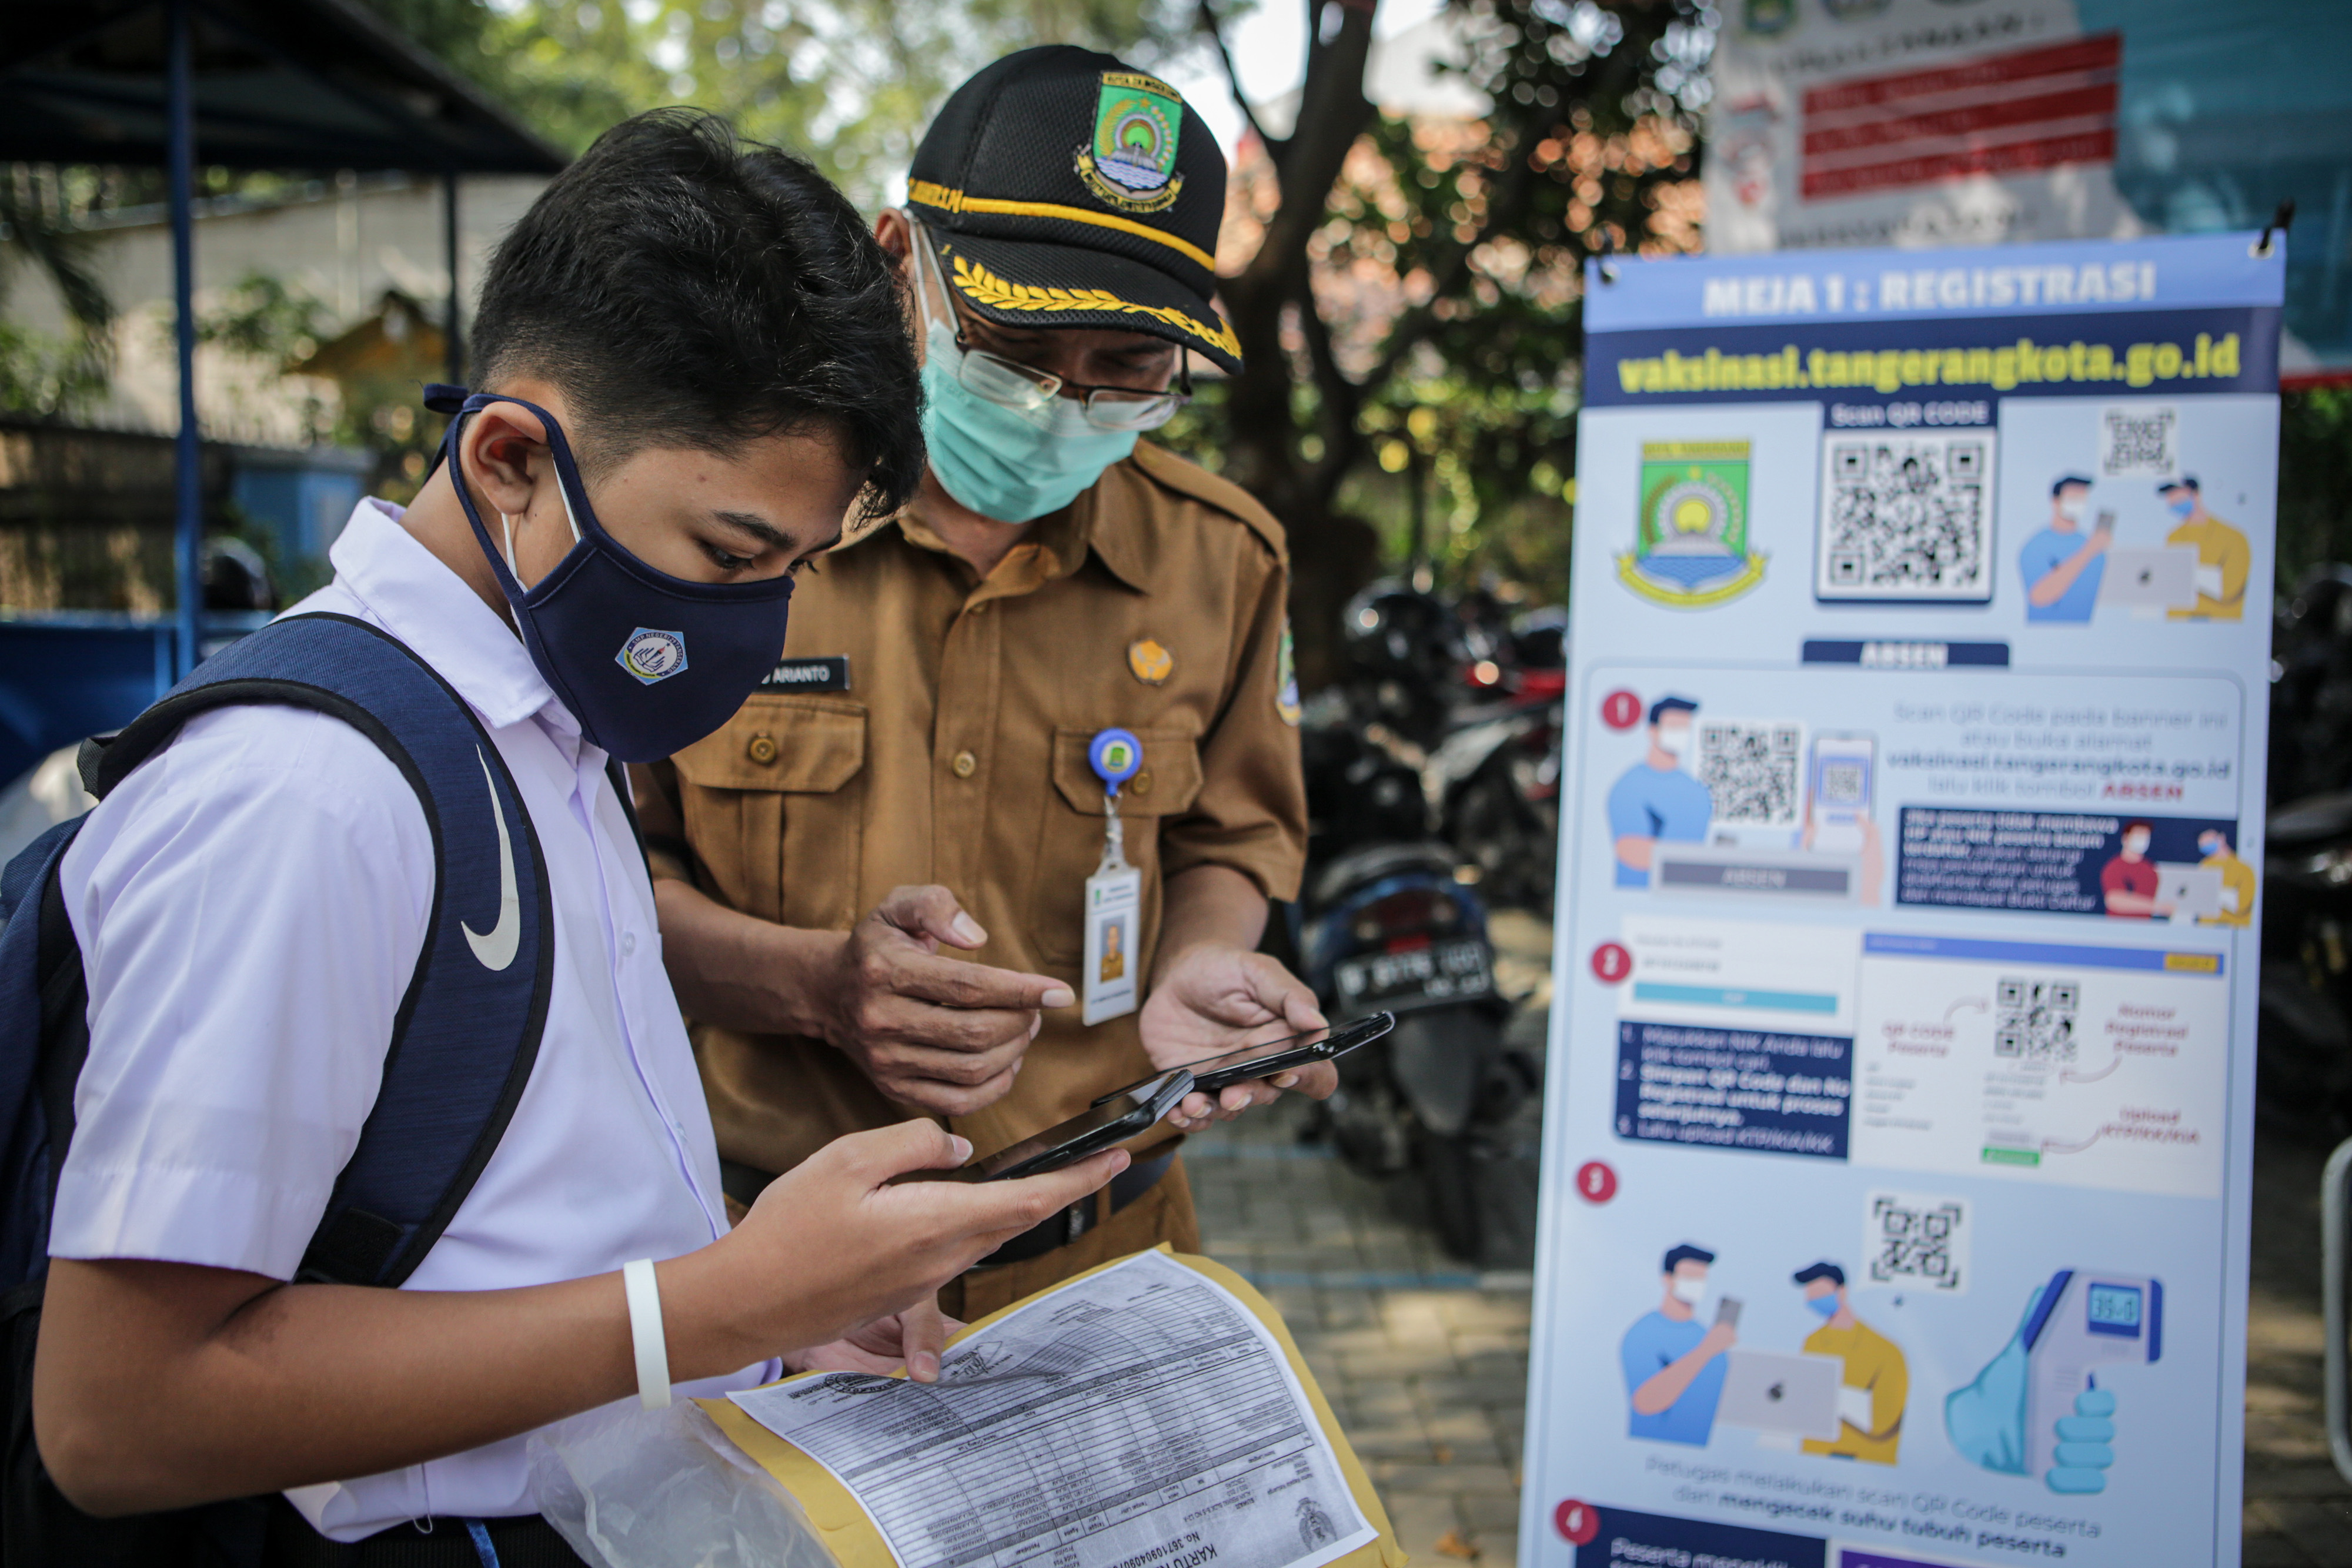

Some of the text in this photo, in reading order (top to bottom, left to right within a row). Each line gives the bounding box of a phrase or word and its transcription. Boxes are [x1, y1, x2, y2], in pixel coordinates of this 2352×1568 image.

[1703, 262, 2156, 317] MEJA 1 : REGISTRASI
[1618, 333, 2241, 394] vaksinasi.tangerangkota.go.id
[1831, 403, 1989, 427] Scan QR CODE
[633, 635, 644, 644] SMP
[668, 641, 683, 673] TANGERANG
[1861, 643, 1947, 669] ABSEN
[773, 665, 830, 684] ARIANTO
[2102, 783, 2184, 801] ABSEN
[1734, 1469, 1853, 1500] melakukan
[1857, 1487, 1909, 1509] scan
[1912, 1492, 1949, 1513] QR
[1951, 1497, 2010, 1524] Code
[2015, 1511, 2102, 1538] peserta
[1183, 1531, 1200, 1545] No.
[1719, 1493, 1833, 1520] mengecek
[1839, 1509, 1897, 1532] suhu
[1902, 1517, 1972, 1543] tubuh
[1977, 1530, 2066, 1559] peserta
[1014, 1542, 1040, 1556] Pendidikan
[1053, 1545, 1074, 1558] Provinsi
[1063, 1553, 1077, 1563] Kode
[1172, 1543, 1217, 1568] KARTU
[1053, 1558, 1063, 1566] Pos
